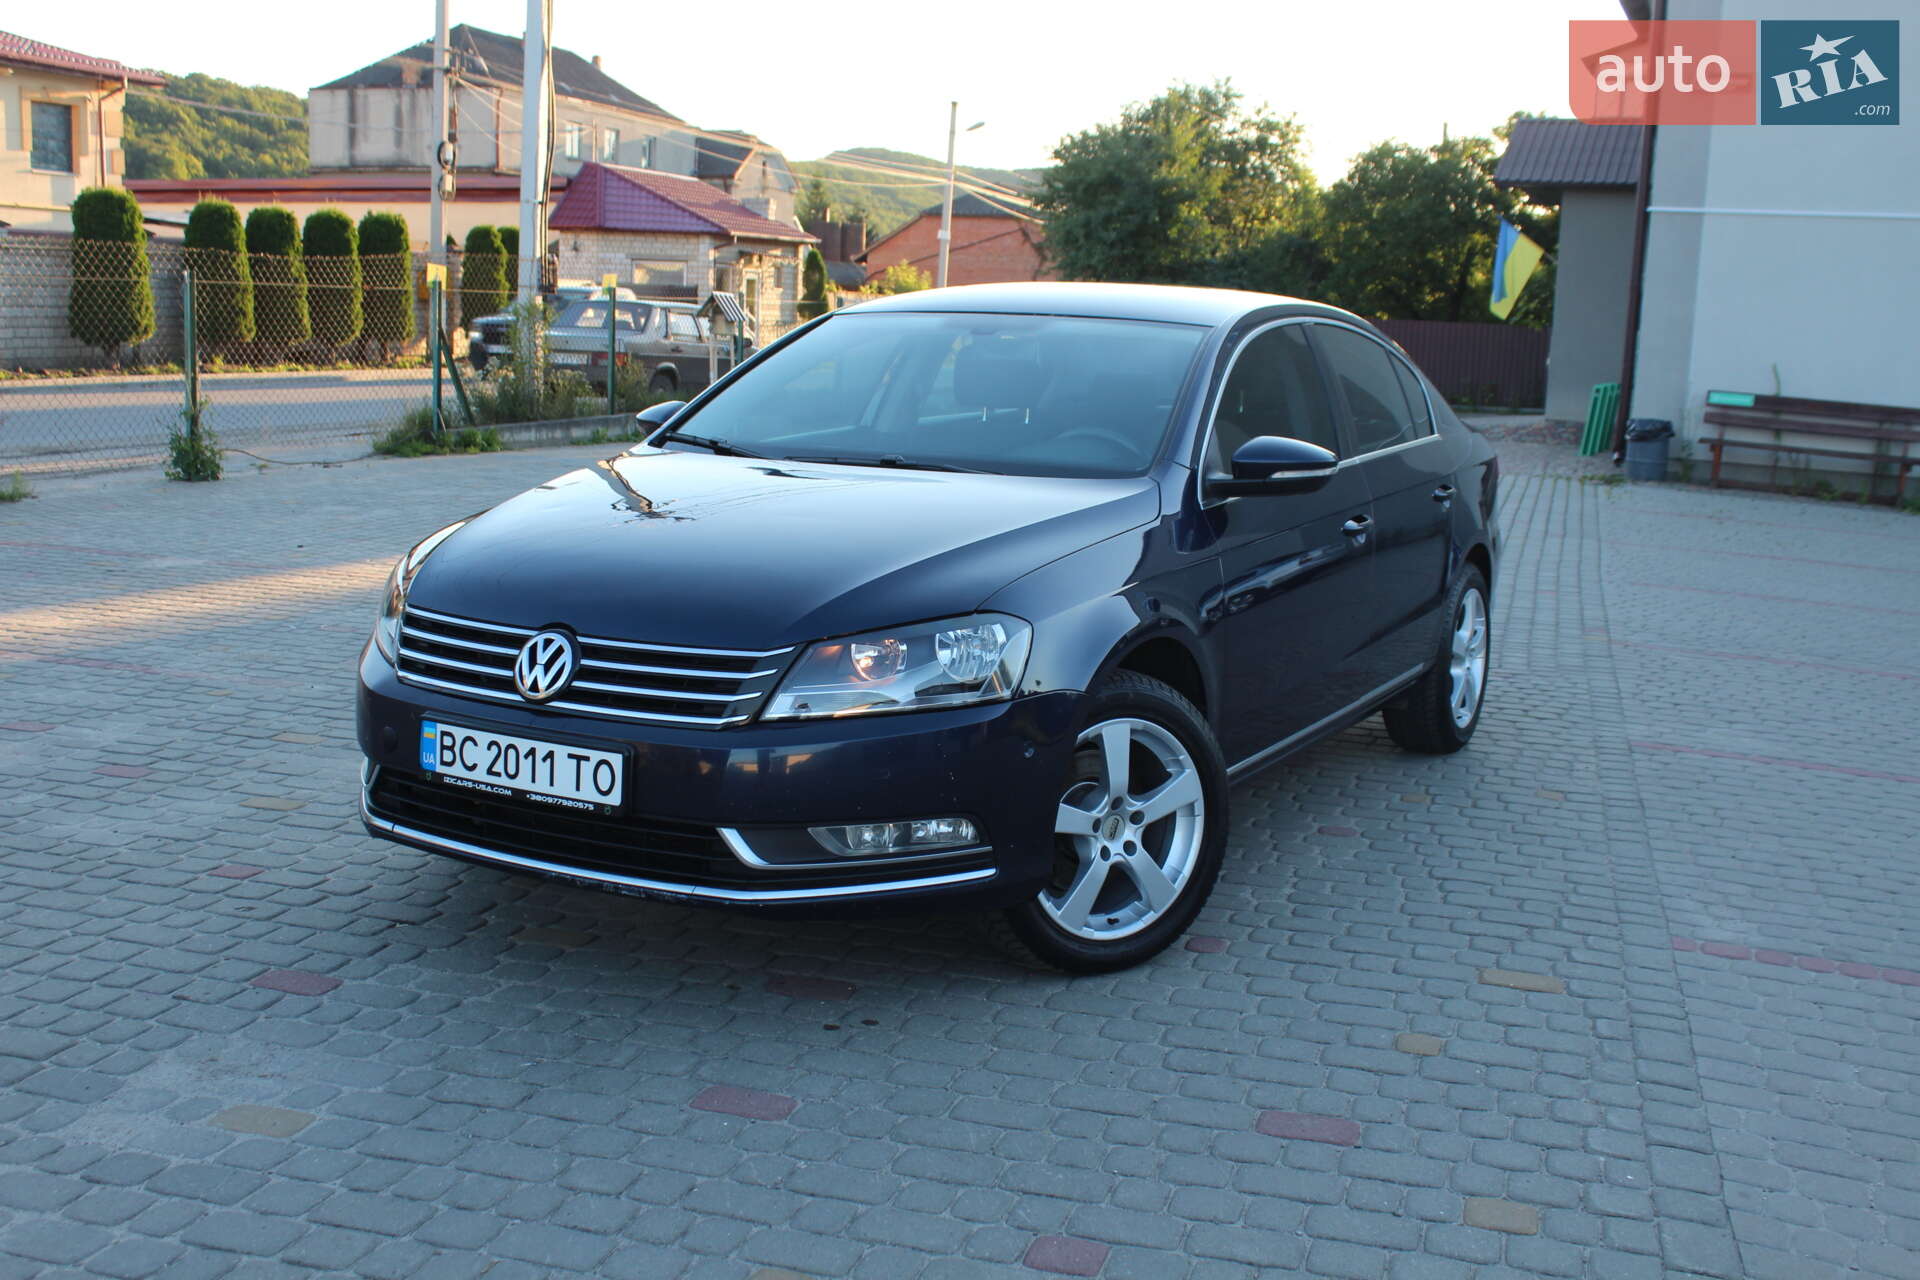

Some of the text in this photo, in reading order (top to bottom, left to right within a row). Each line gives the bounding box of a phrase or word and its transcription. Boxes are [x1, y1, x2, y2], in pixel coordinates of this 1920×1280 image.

[423, 751, 435, 765] UA
[439, 730, 616, 797] BC 2011 TO
